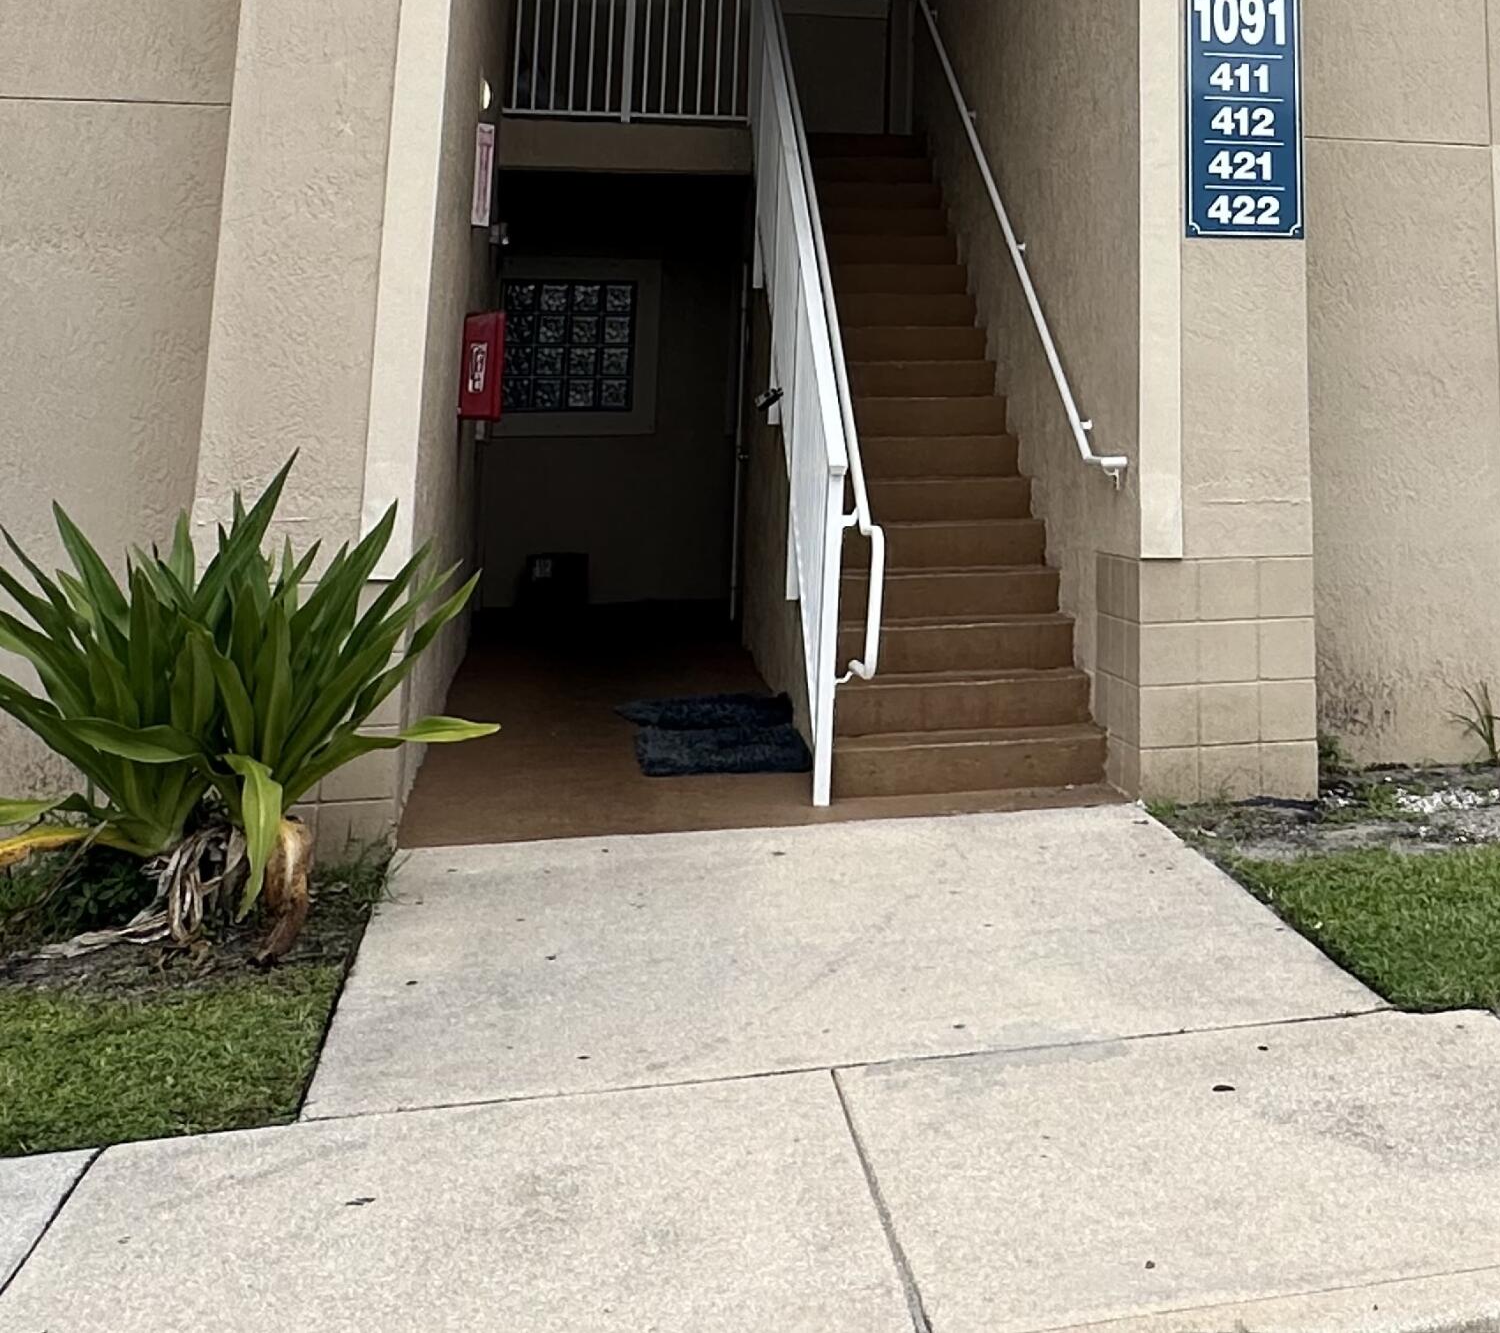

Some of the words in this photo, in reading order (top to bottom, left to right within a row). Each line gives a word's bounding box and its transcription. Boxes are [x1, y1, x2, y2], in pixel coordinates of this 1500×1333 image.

[1210, 63, 1268, 92] 411
[1212, 107, 1274, 136] 412
[1209, 151, 1271, 180] 421
[1208, 195, 1279, 224] 422
